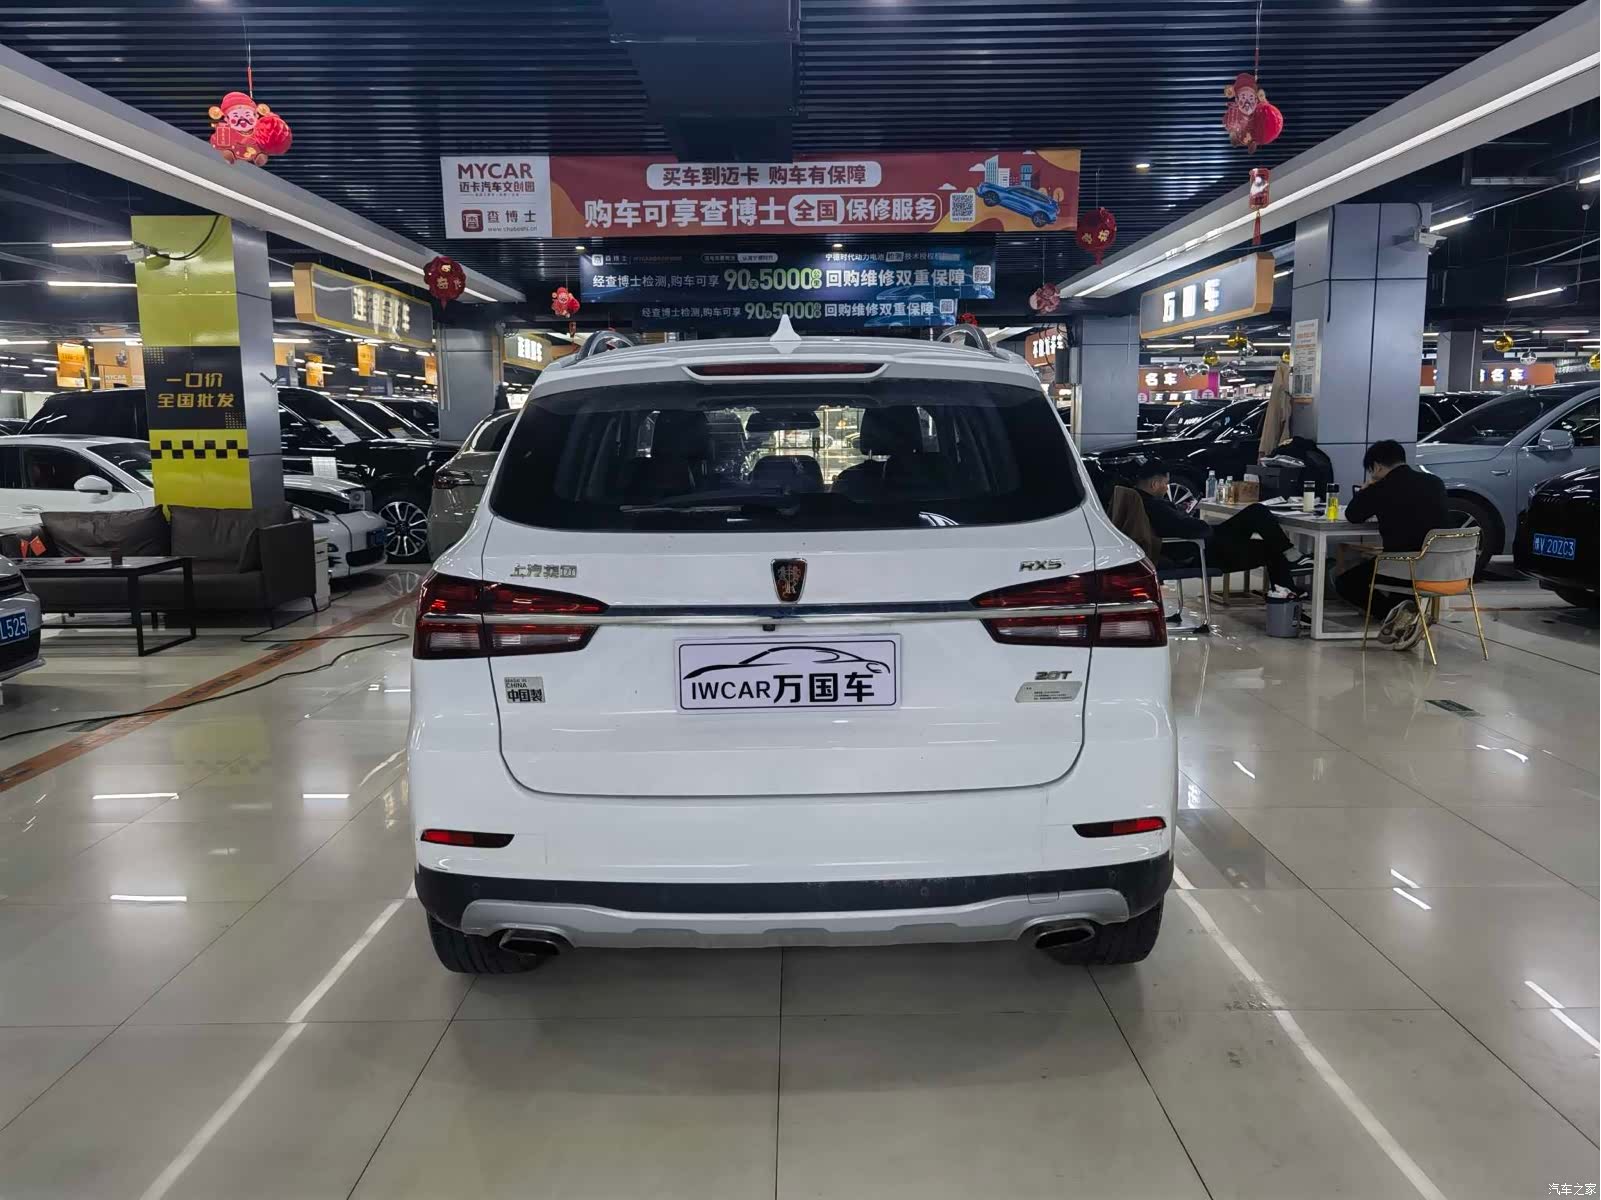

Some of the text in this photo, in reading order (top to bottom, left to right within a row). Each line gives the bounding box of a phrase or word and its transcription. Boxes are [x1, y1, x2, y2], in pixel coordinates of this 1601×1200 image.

[457, 163, 533, 179] MYCAR
[663, 165, 867, 186] 买车到迈卡 购车有保障
[487, 210, 536, 223] 查博士
[825, 269, 965, 288] 回购维修双重保障
[824, 302, 934, 318] 回购维修双重保障
[166, 372, 223, 388] 一口价
[157, 393, 235, 408] 全国批发
[1019, 558, 1062, 572] RX5
[1034, 670, 1073, 681] 20T
[507, 688, 543, 702] 中国製
